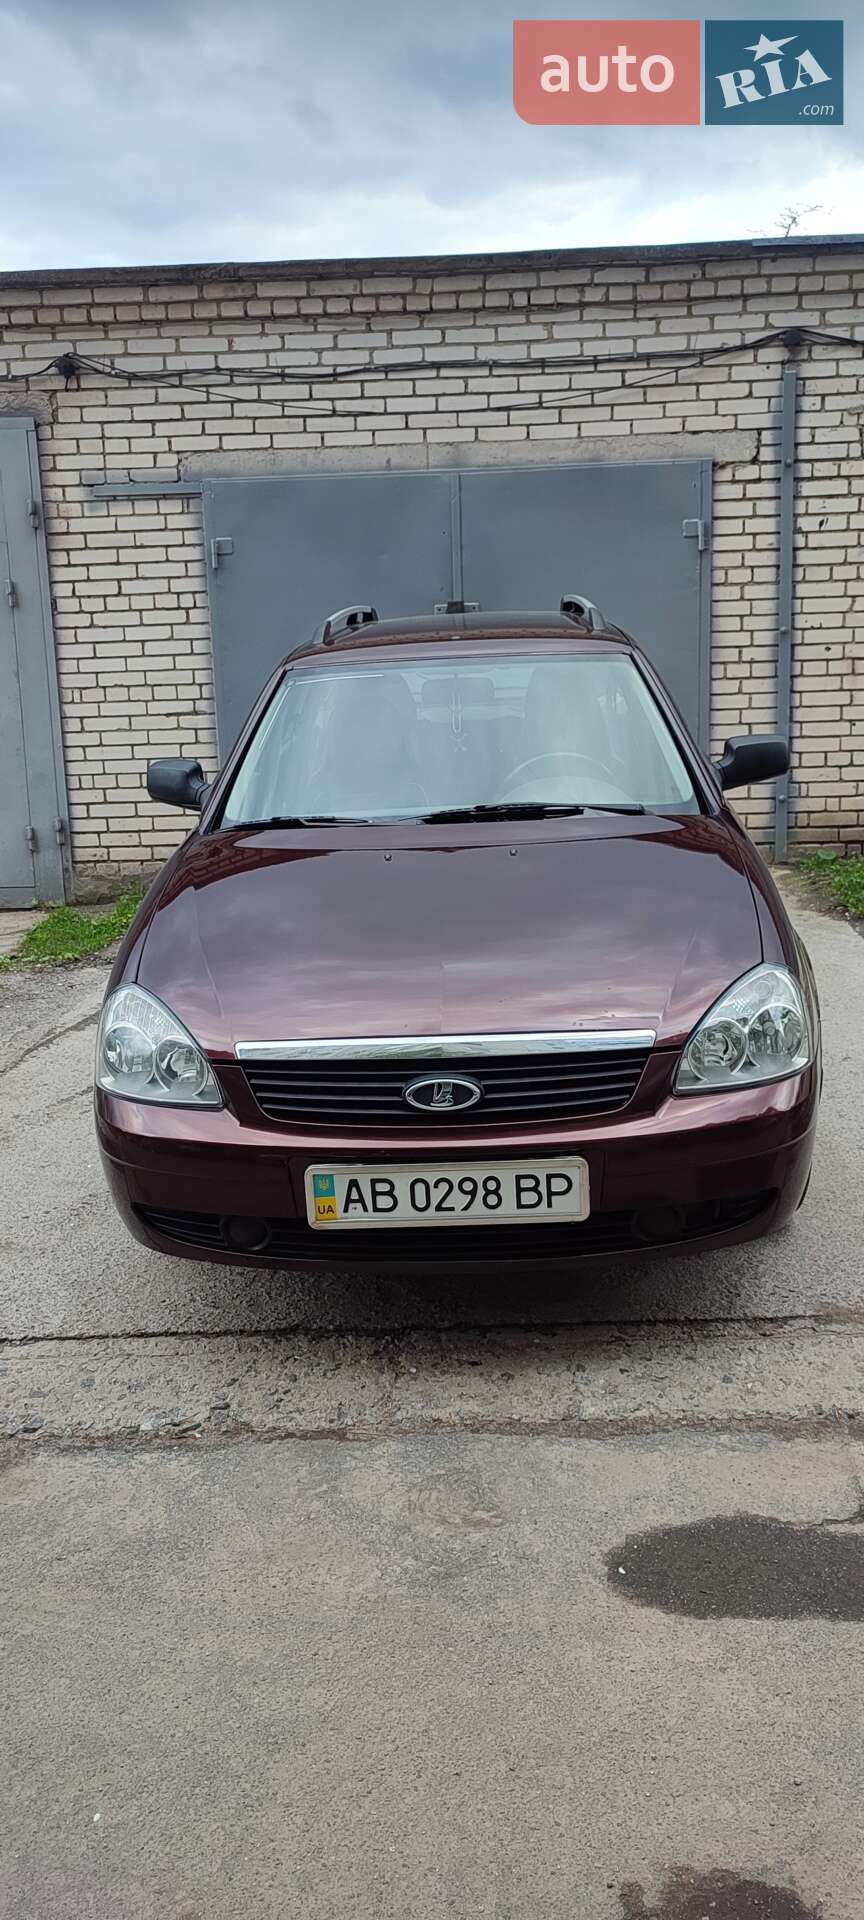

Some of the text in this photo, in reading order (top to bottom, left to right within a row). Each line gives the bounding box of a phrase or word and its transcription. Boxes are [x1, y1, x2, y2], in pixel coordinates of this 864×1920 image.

[343, 1173, 573, 1213] AB 0298 BP
[317, 1204, 335, 1215] UA
